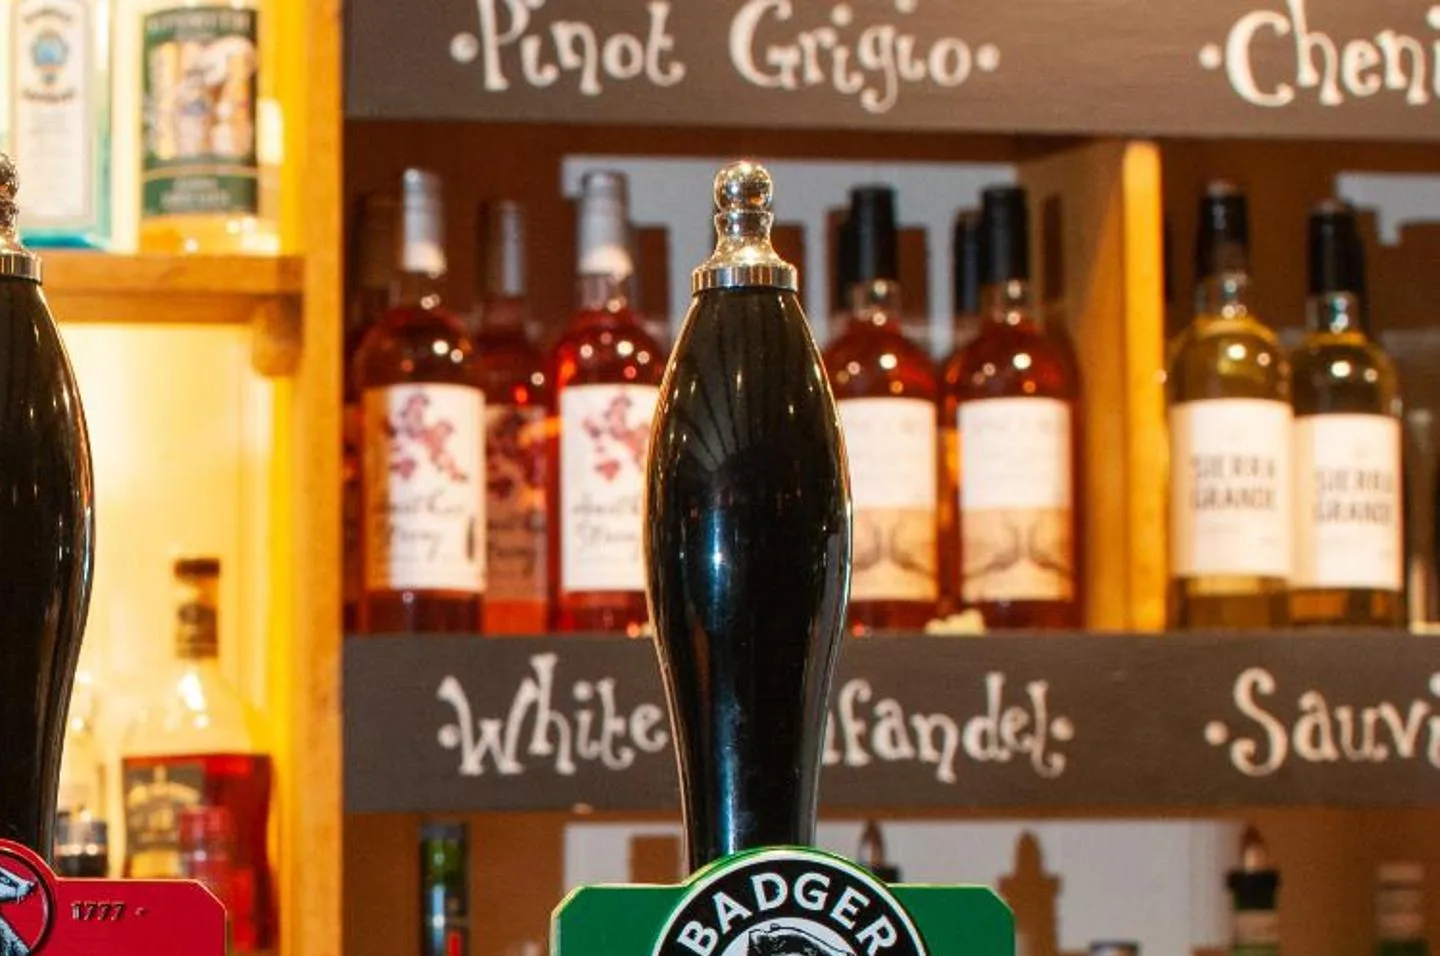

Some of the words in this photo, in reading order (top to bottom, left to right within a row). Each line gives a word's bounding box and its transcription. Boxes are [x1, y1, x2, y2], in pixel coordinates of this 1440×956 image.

[477, 0, 685, 95] Pinot
[729, 0, 972, 113] Grigio
[438, 653, 669, 775] White
[822, 672, 1067, 783] fandel
[70, 901, 127, 921] 1777
